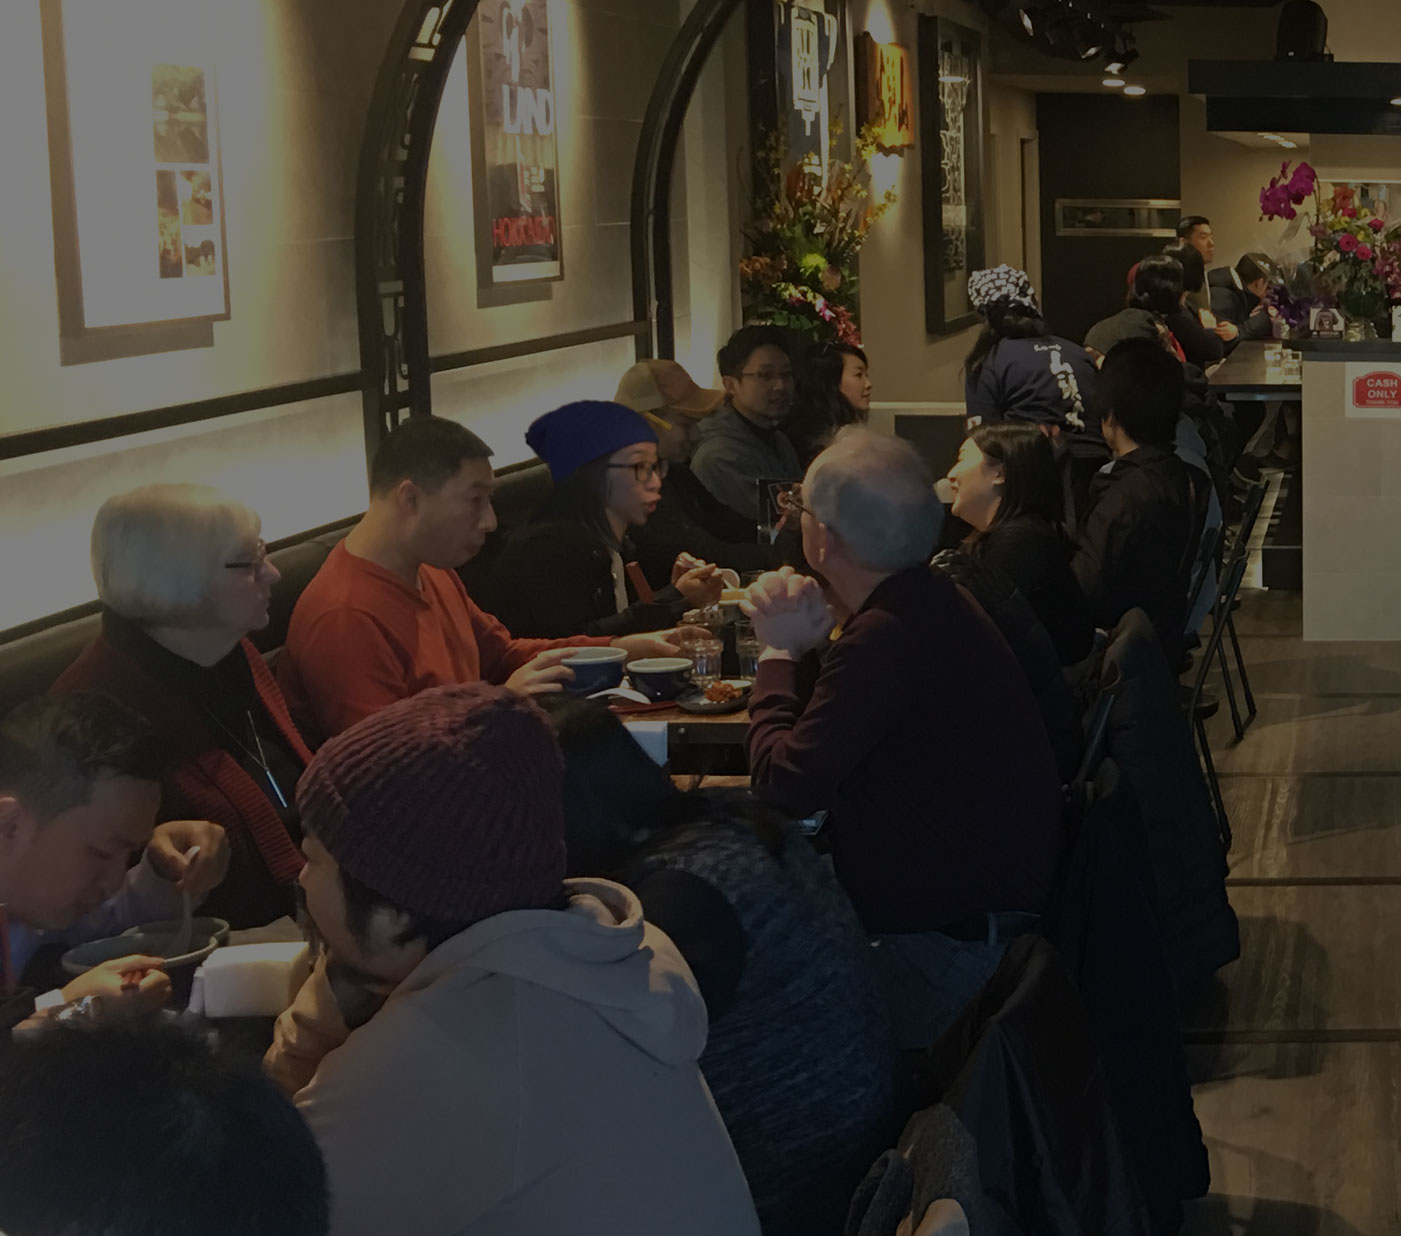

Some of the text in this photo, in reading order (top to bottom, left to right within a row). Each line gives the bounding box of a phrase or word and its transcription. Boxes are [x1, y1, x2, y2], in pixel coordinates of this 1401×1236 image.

[502, 84, 554, 136] LAND
[1366, 378, 1398, 388] CASH
[1367, 389, 1398, 399] ONLY
